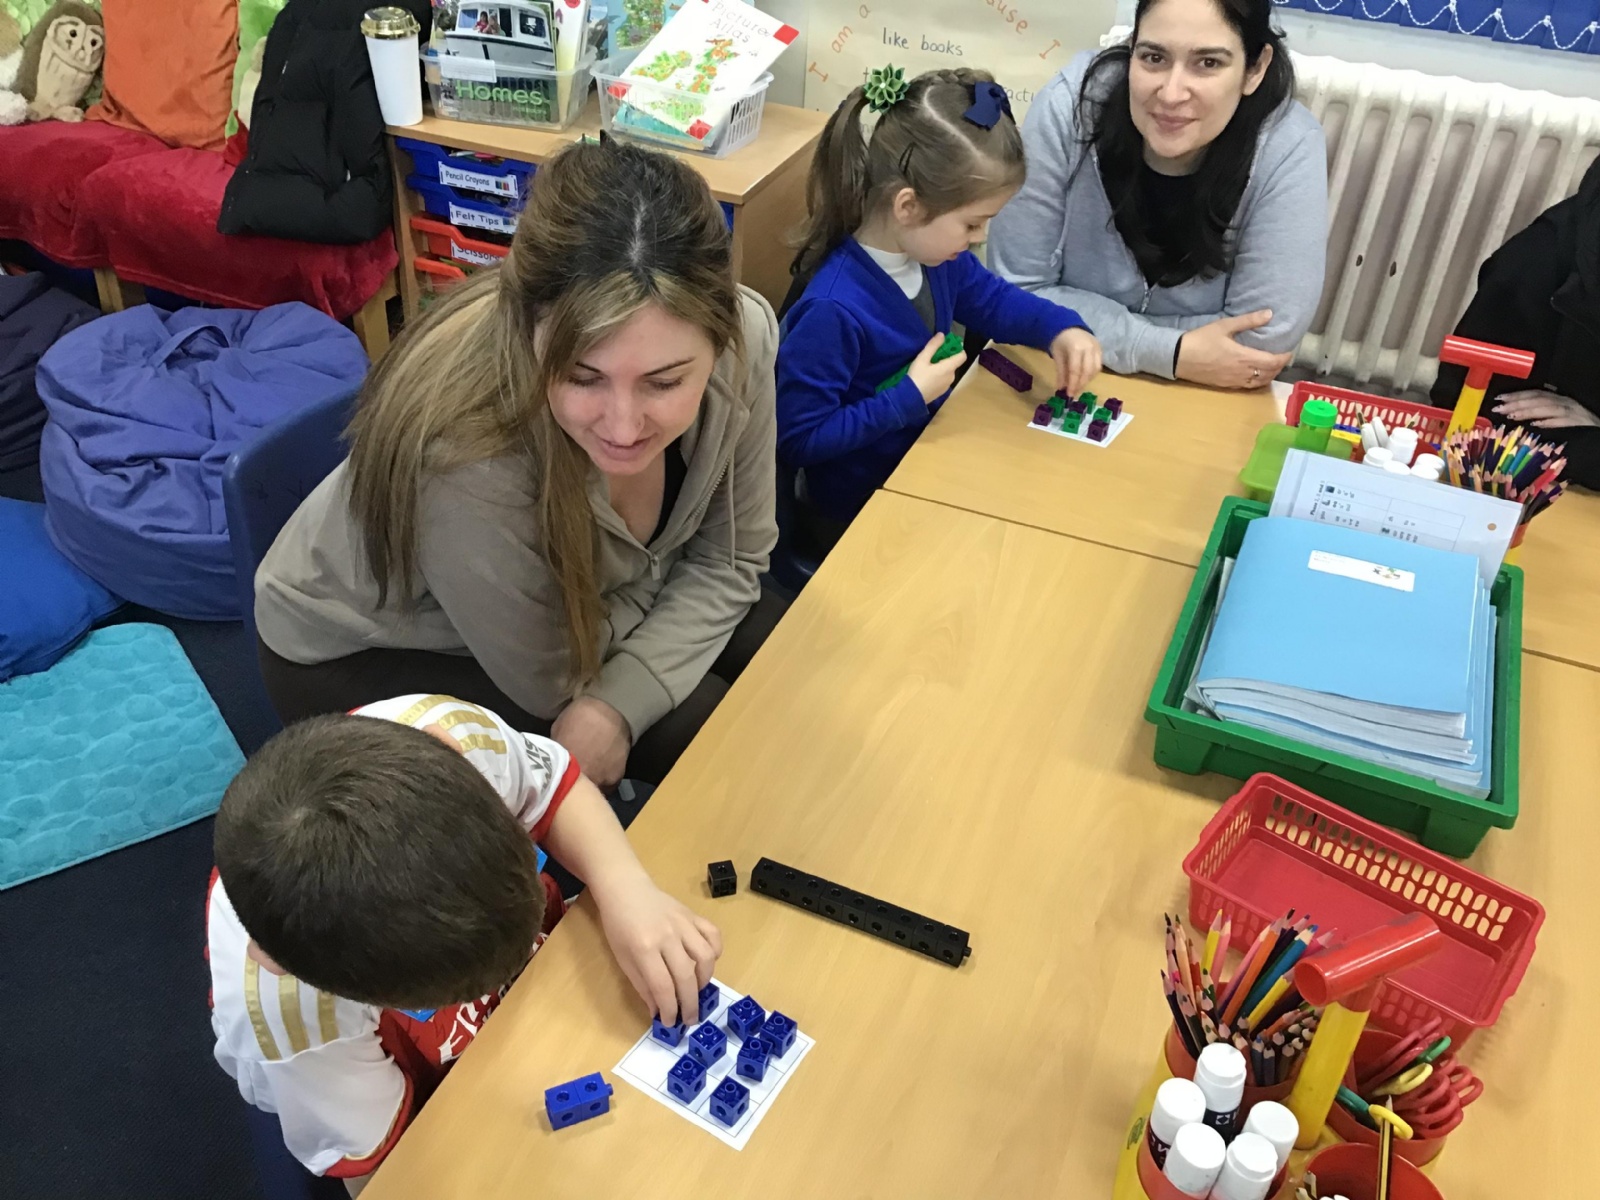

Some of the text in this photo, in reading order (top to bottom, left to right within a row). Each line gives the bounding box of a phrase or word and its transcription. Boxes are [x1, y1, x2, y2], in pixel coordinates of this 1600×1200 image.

[831, 25, 853, 54] am
[859, 4, 872, 19] a
[985, 0, 1028, 35] ause
[882, 27, 963, 56] like books
[455, 79, 543, 106] Homes
[445, 170, 490, 187] Pencil Crayons
[456, 210, 499, 226] Felt Tips
[522, 733, 544, 770] VIS
